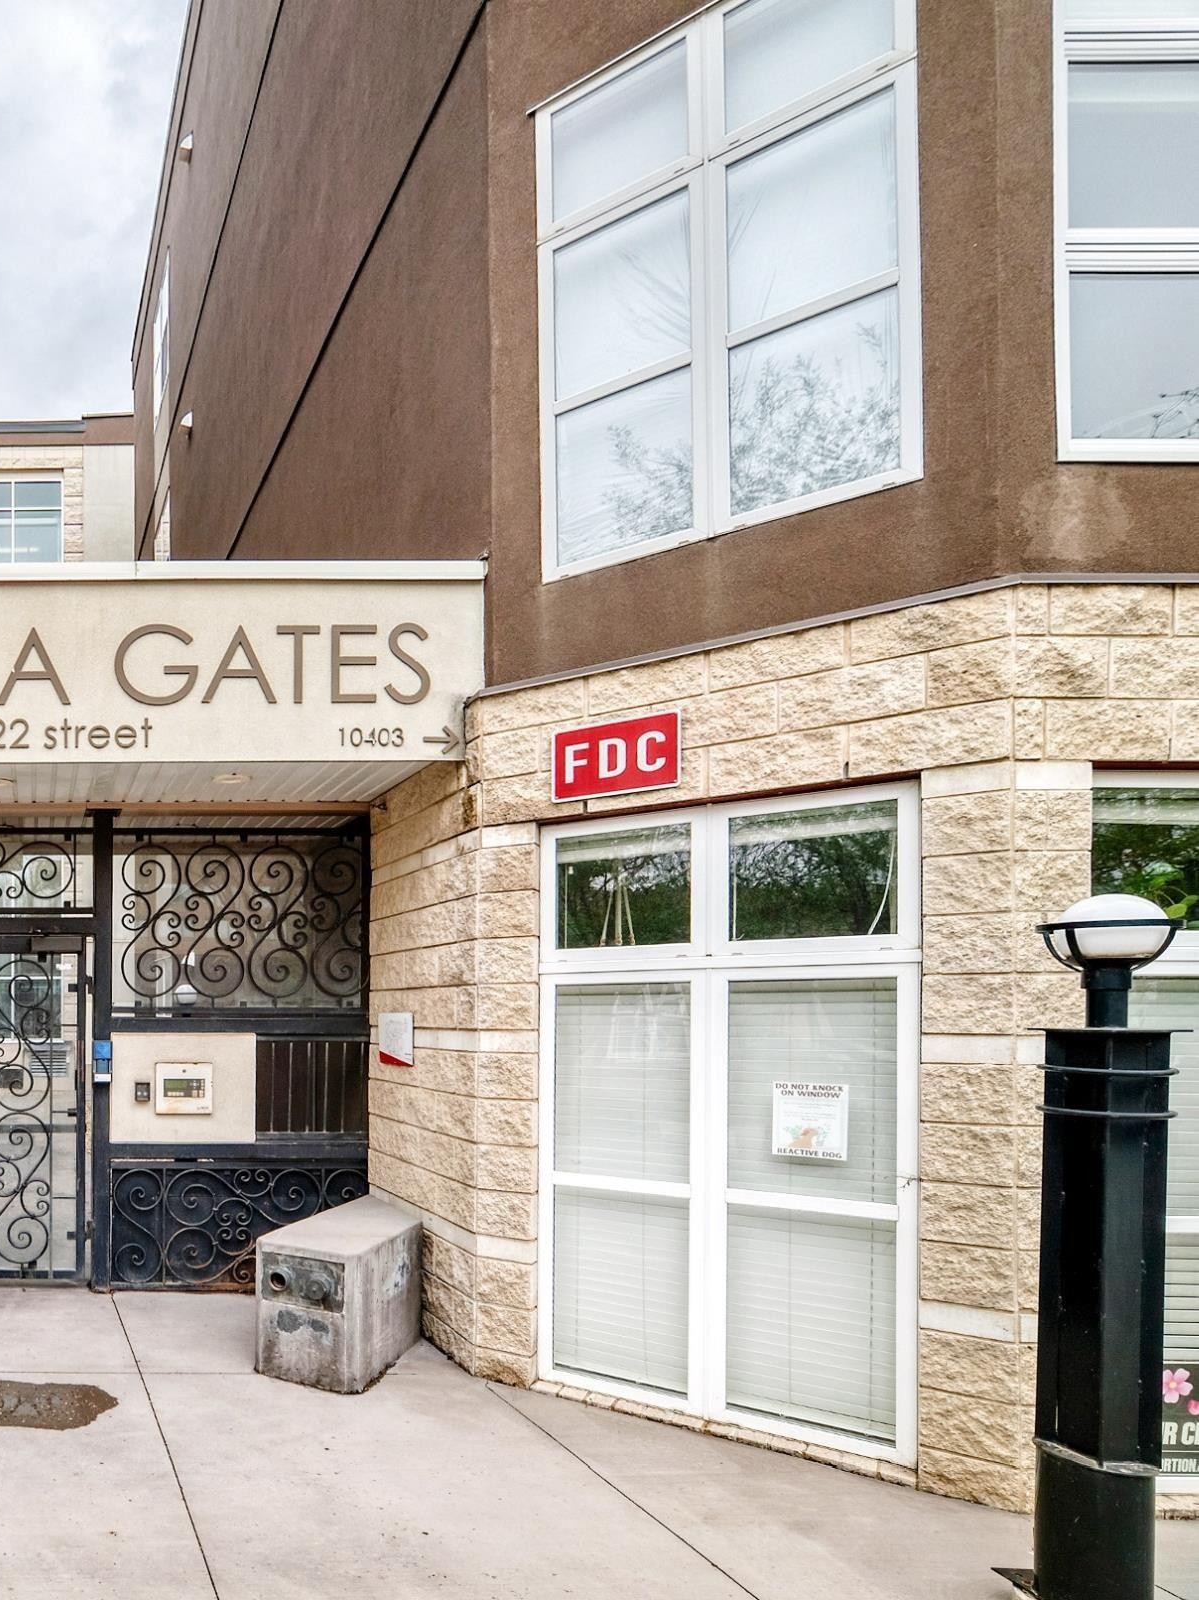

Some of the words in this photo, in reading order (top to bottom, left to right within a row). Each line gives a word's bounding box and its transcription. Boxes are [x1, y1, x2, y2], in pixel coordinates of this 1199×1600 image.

[114, 622, 431, 707] GATES
[43, 717, 154, 750] street
[338, 727, 405, 748] 10403
[565, 730, 667, 784] FDC
[812, 1084, 844, 1092] KNOCK
[777, 1148, 819, 1156] REACTIVE
[1162, 1421, 1179, 1445] R
